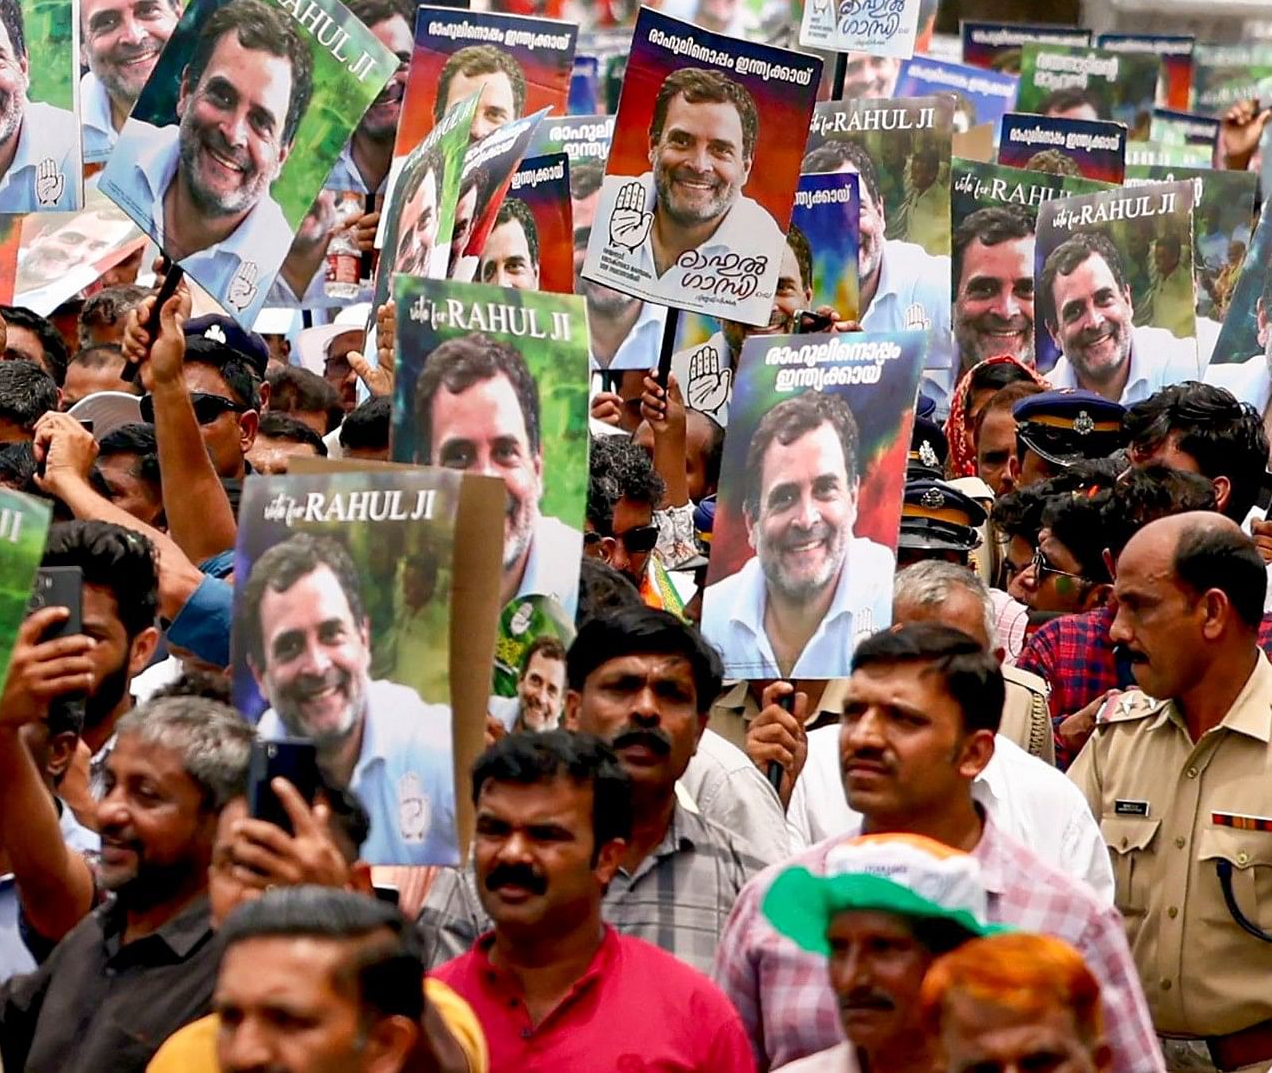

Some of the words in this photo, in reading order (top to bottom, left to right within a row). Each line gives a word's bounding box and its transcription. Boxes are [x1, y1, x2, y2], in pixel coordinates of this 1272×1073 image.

[348, 51, 377, 82] JI
[834, 109, 912, 132] RAHUL
[916, 108, 935, 129] JI
[1079, 195, 1156, 226] RAHUL
[1158, 192, 1175, 214] JI
[446, 298, 546, 339] RAHUL
[550, 311, 571, 341] JI
[303, 490, 408, 522] RAHUL
[410, 489, 436, 520] JI
